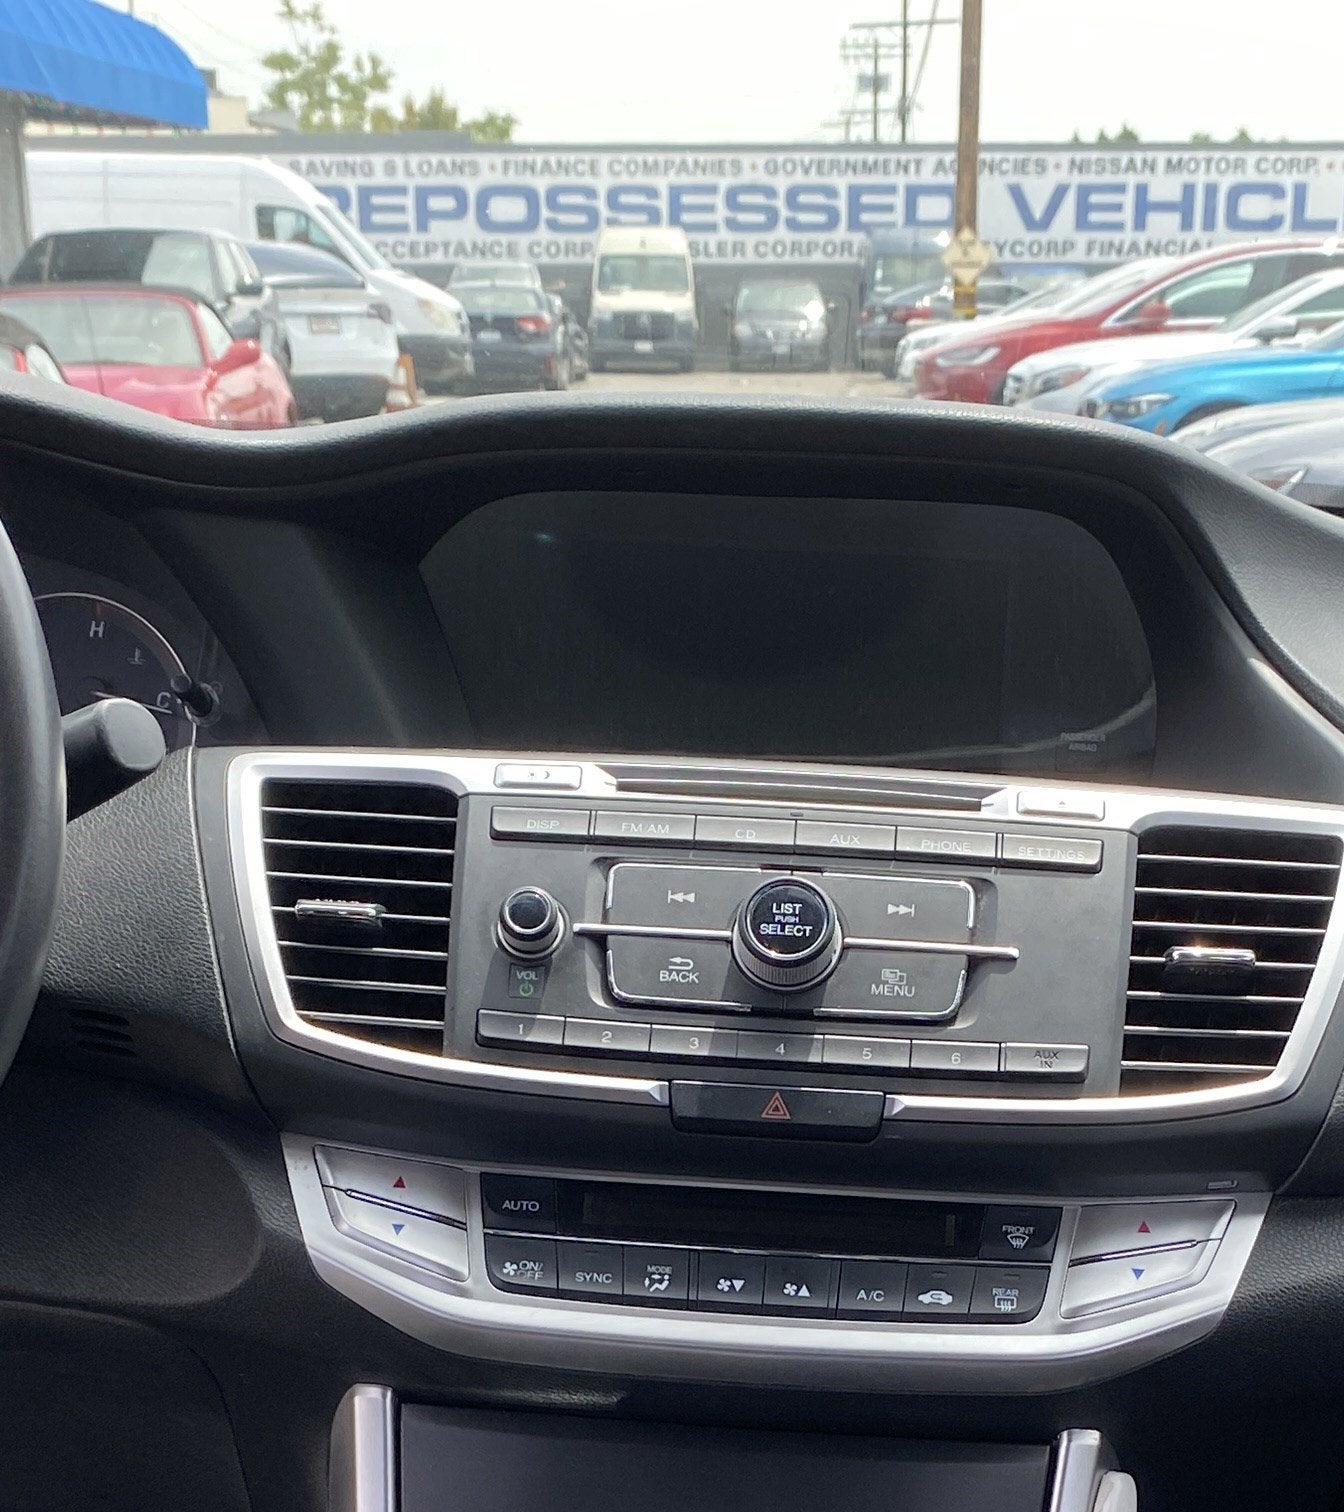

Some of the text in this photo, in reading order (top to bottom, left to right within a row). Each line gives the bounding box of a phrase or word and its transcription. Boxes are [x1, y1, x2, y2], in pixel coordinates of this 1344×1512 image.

[406, 159, 480, 177] LOANS
[502, 159, 600, 177] FINANCE
[607, 158, 742, 177] COMPANIES
[764, 157, 923, 177] GOVERNMENT
[932, 156, 1047, 176] AGNCIES
[1068, 155, 1156, 176] NISSAN
[1164, 155, 1246, 175] MOTOR
[373, 240, 523, 259] CCEPTANCE
[688, 239, 746, 259] SLER
[992, 238, 1075, 258] YCORP
[89, 620, 105, 639] H
[526, 818, 560, 830] DISP
[621, 822, 670, 834] FM/AM
[734, 829, 756, 840] CD
[829, 833, 861, 845] AUX
[921, 839, 971, 852] PHONE
[1018, 846, 1085, 860] SETTINGS
[772, 902, 802, 915] LIST
[775, 915, 799, 923] PUSH
[759, 924, 813, 937] SELECT
[516, 970, 538, 981] VOL
[659, 970, 699, 984] BACK
[871, 983, 915, 997] MENU
[601, 1031, 613, 1043] 2
[688, 1037, 700, 1049] 3
[774, 1043, 786, 1055] 4
[861, 1047, 873, 1060] 5
[1033, 1050, 1060, 1060] AUX
[950, 1052, 962, 1065] 6
[1039, 1060, 1054, 1069] IN
[502, 1199, 540, 1213] AUTO
[1002, 1225, 1035, 1236] FRONT
[519, 1270, 544, 1281] OFF
[646, 1264, 673, 1275] MODE
[575, 1271, 613, 1284] SYNC
[856, 1288, 885, 1302] A/C
[992, 1288, 1020, 1298] REAR
